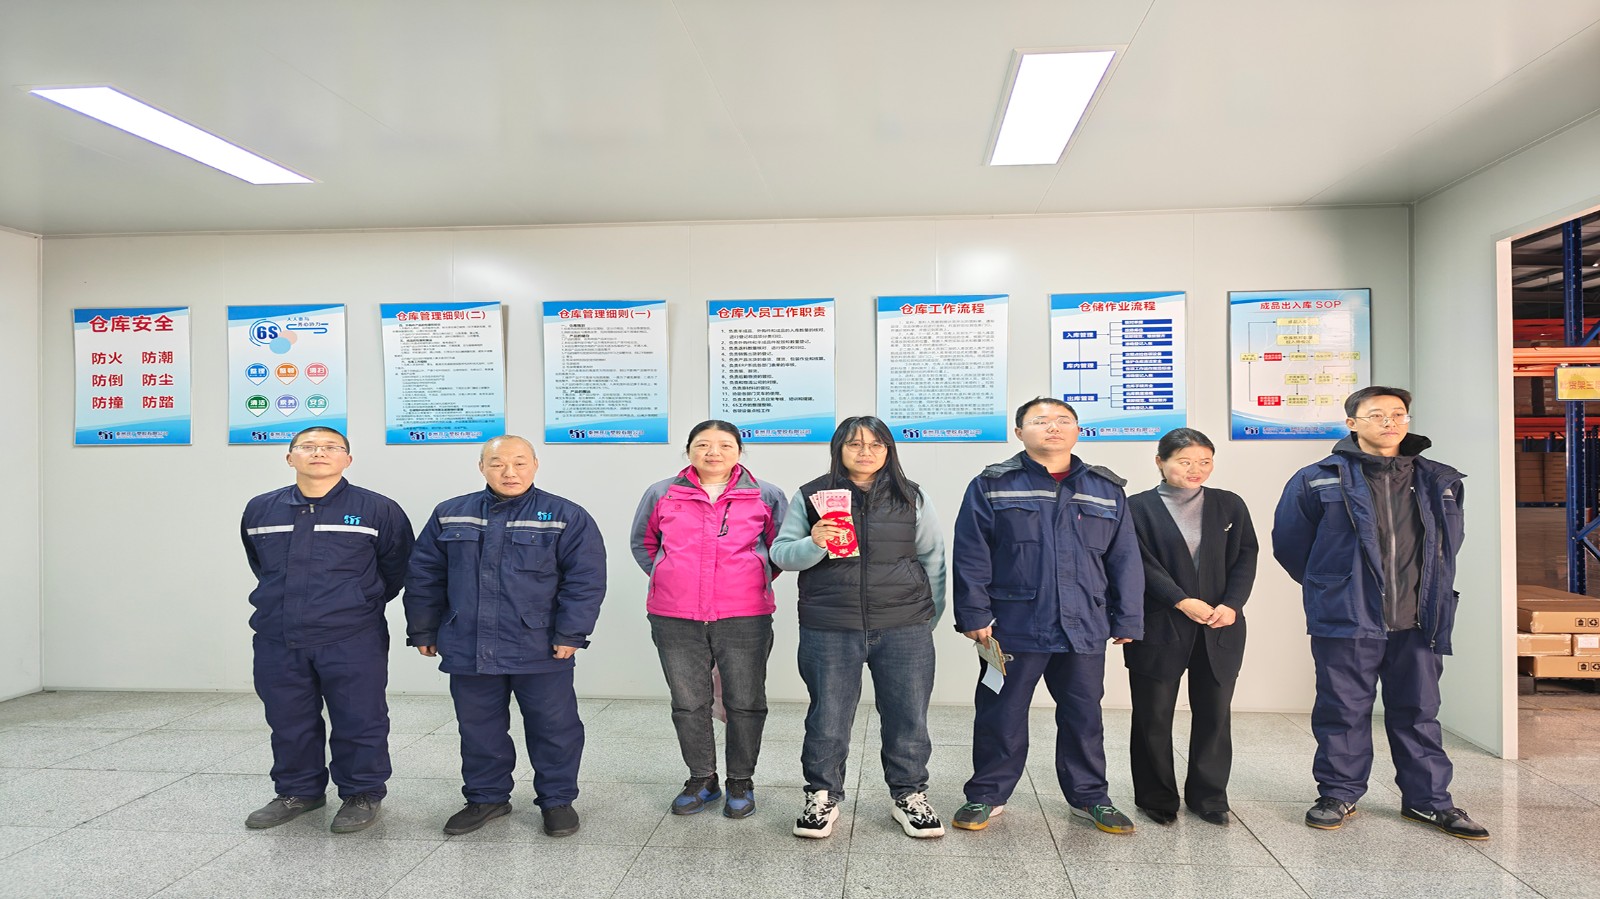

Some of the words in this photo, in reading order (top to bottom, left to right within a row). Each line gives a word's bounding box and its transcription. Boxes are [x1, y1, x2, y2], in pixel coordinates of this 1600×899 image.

[900, 303, 985, 314] 仓库工作流程
[1080, 302, 1156, 311] 仓储作业流程
[1260, 301, 1312, 310] 成品出入库
[397, 311, 486, 320] 仓库管理细则(二)
[559, 309, 651, 319] 仓库管理细则(一)
[718, 307, 826, 318] 仓库人员工作职责
[89, 315, 174, 332] 仓库安全
[256, 326, 278, 340] 6S
[91, 352, 123, 364] 防火
[142, 352, 173, 364] 防潮
[92, 374, 123, 387] 防倒
[142, 374, 174, 386] 防尘
[92, 396, 124, 409] 防撞
[142, 396, 174, 408] 防踏
